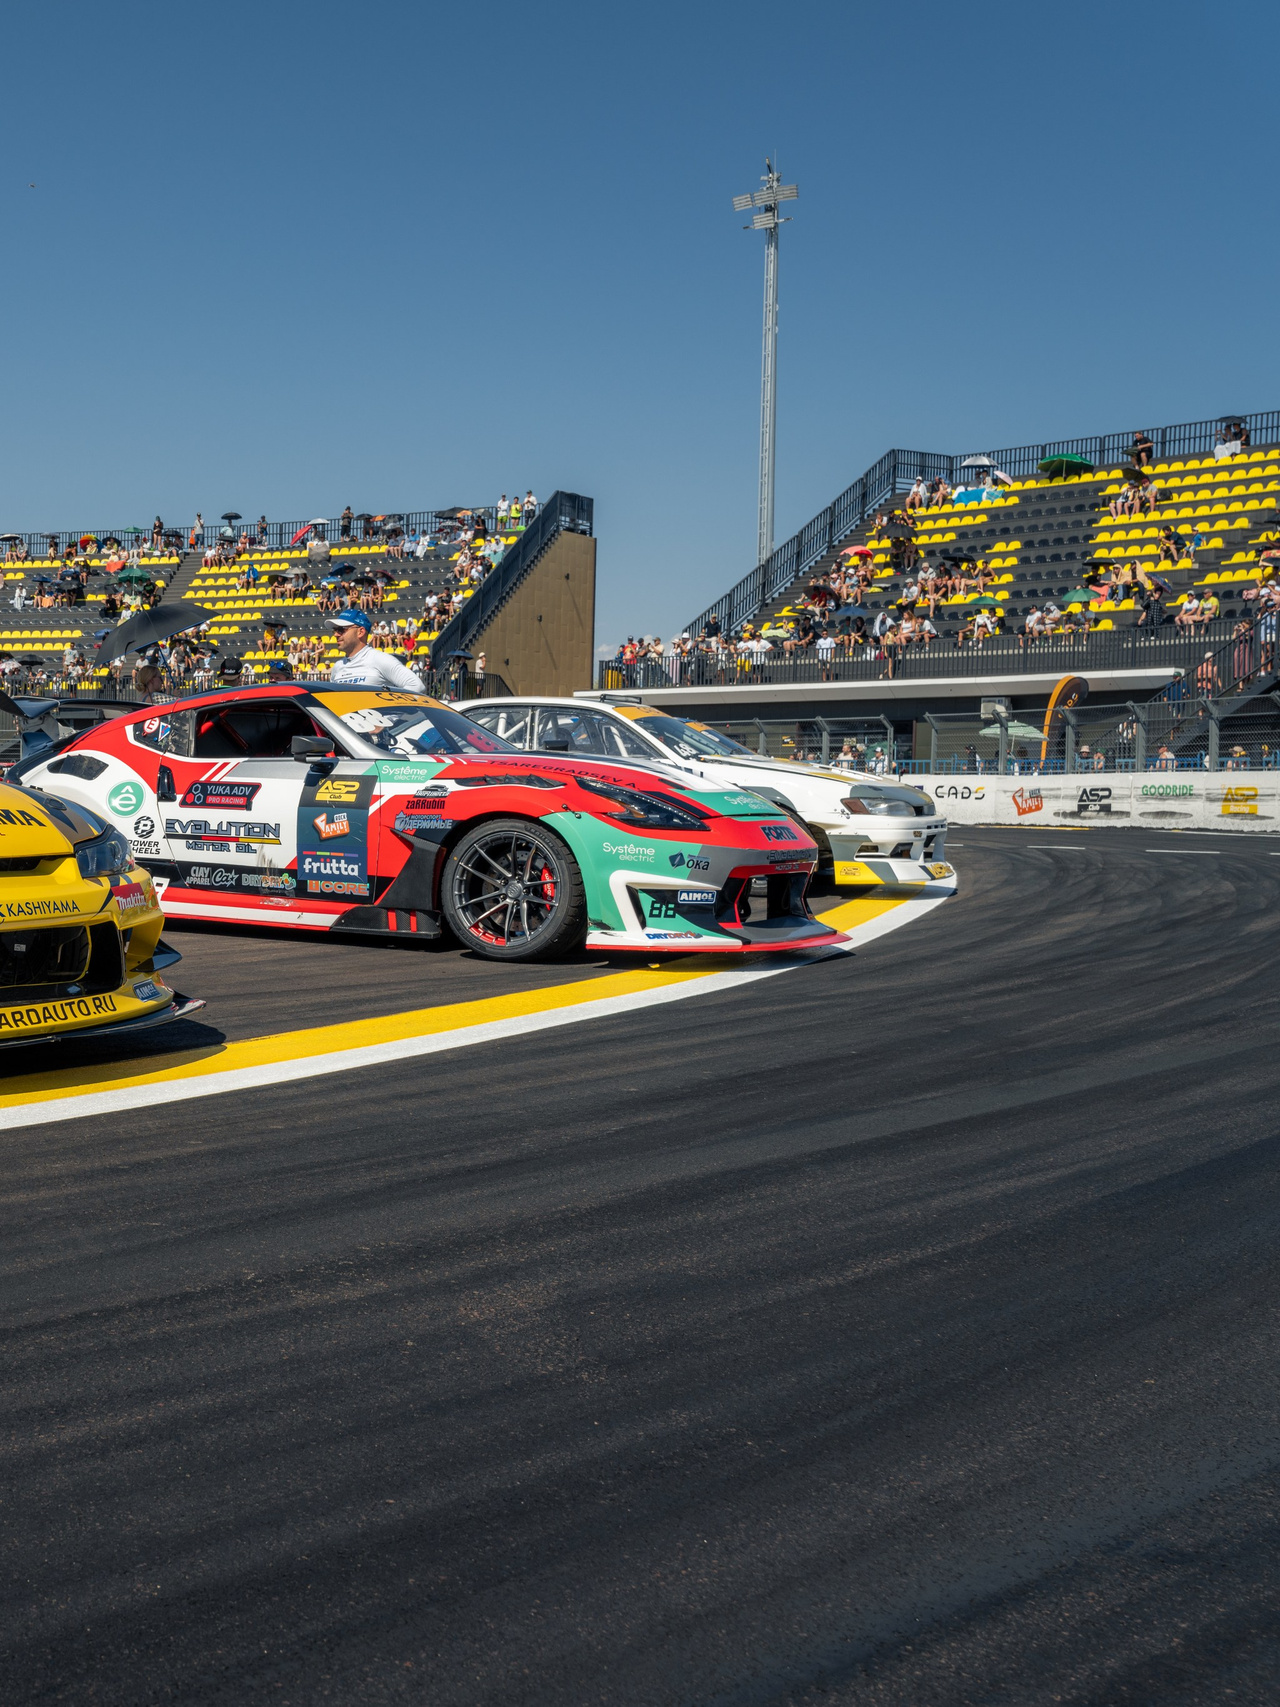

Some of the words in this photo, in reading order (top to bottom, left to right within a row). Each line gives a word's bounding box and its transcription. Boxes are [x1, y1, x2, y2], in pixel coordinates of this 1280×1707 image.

[207, 785, 231, 795] YUKA
[231, 786, 252, 796] ADV
[317, 780, 360, 794] ASP
[934, 785, 985, 800] CADS
[1141, 784, 1194, 797] GOODRIDE
[220, 797, 244, 805] RACING
[1077, 787, 1112, 803] ASP
[1222, 786, 1259, 804] ASP
[165, 819, 281, 838] EVOLUTION
[186, 841, 231, 852] MOTOR
[235, 843, 257, 854] OIL
[602, 842, 656, 856] Systême
[618, 853, 656, 863] electric
[680, 892, 714, 901] AIMOL
[7, 900, 81, 917] KASHIYAMA
